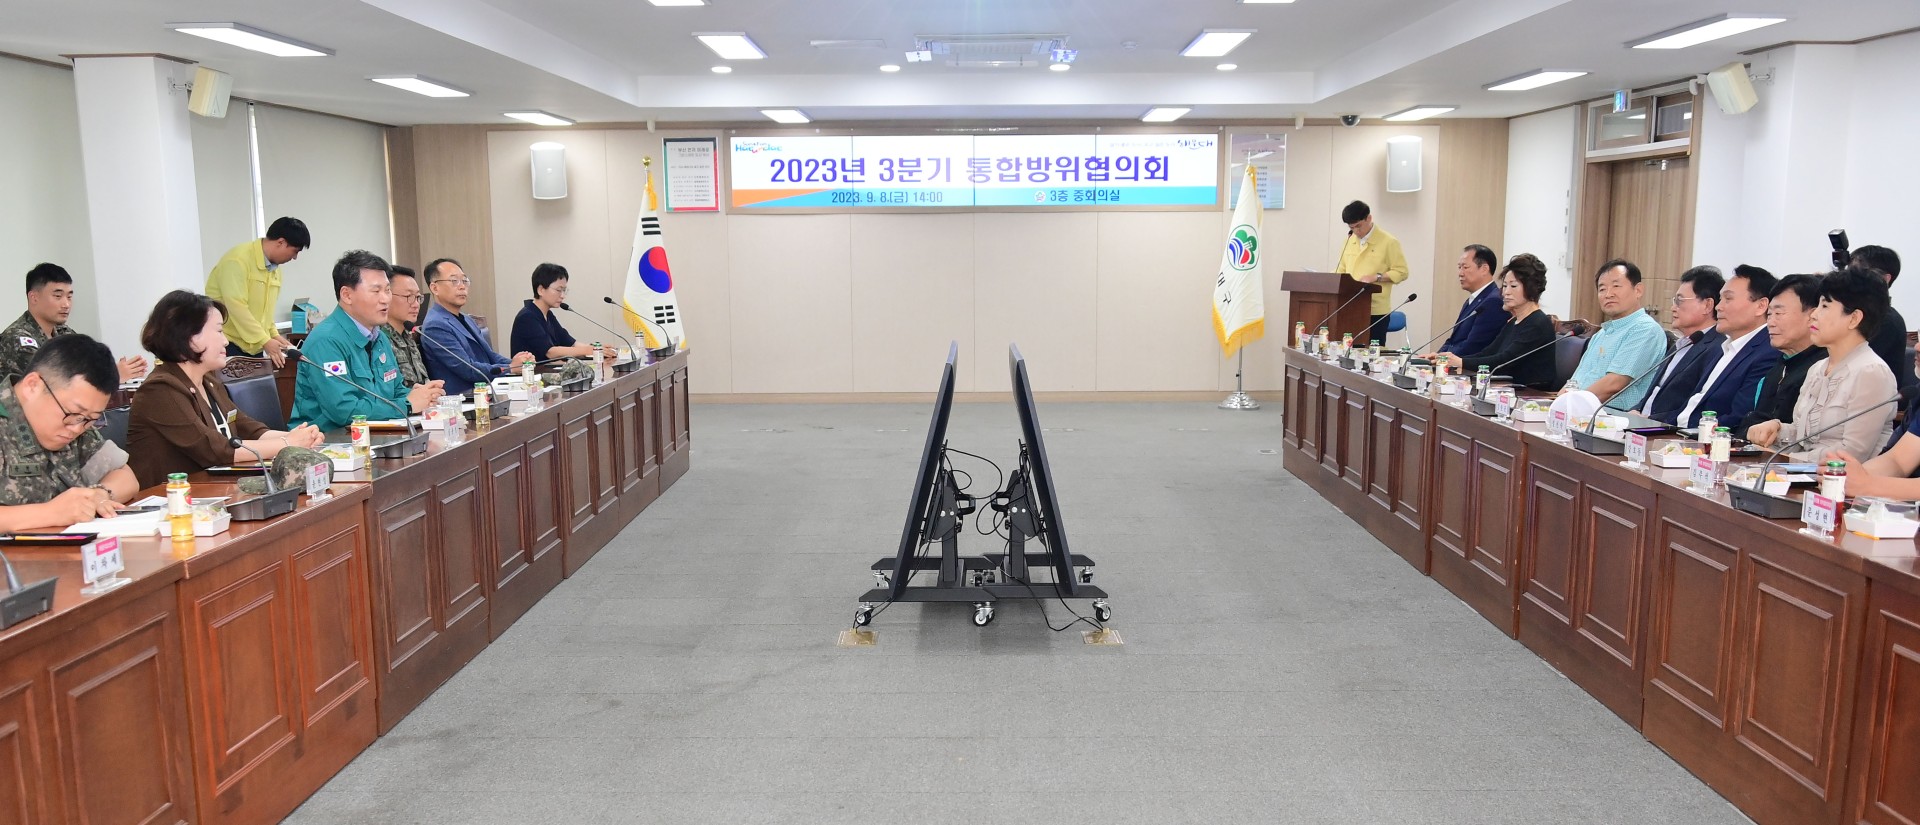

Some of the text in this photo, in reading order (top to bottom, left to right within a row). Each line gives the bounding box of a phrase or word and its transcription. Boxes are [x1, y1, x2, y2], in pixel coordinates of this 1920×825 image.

[770, 155, 1169, 184] 2023년 3분기 통합방위협의회
[831, 191, 863, 204] 2023.
[866, 191, 877, 203] 9.
[913, 191, 943, 203] 14:00
[1050, 189, 1121, 202] 3층 중회의실
